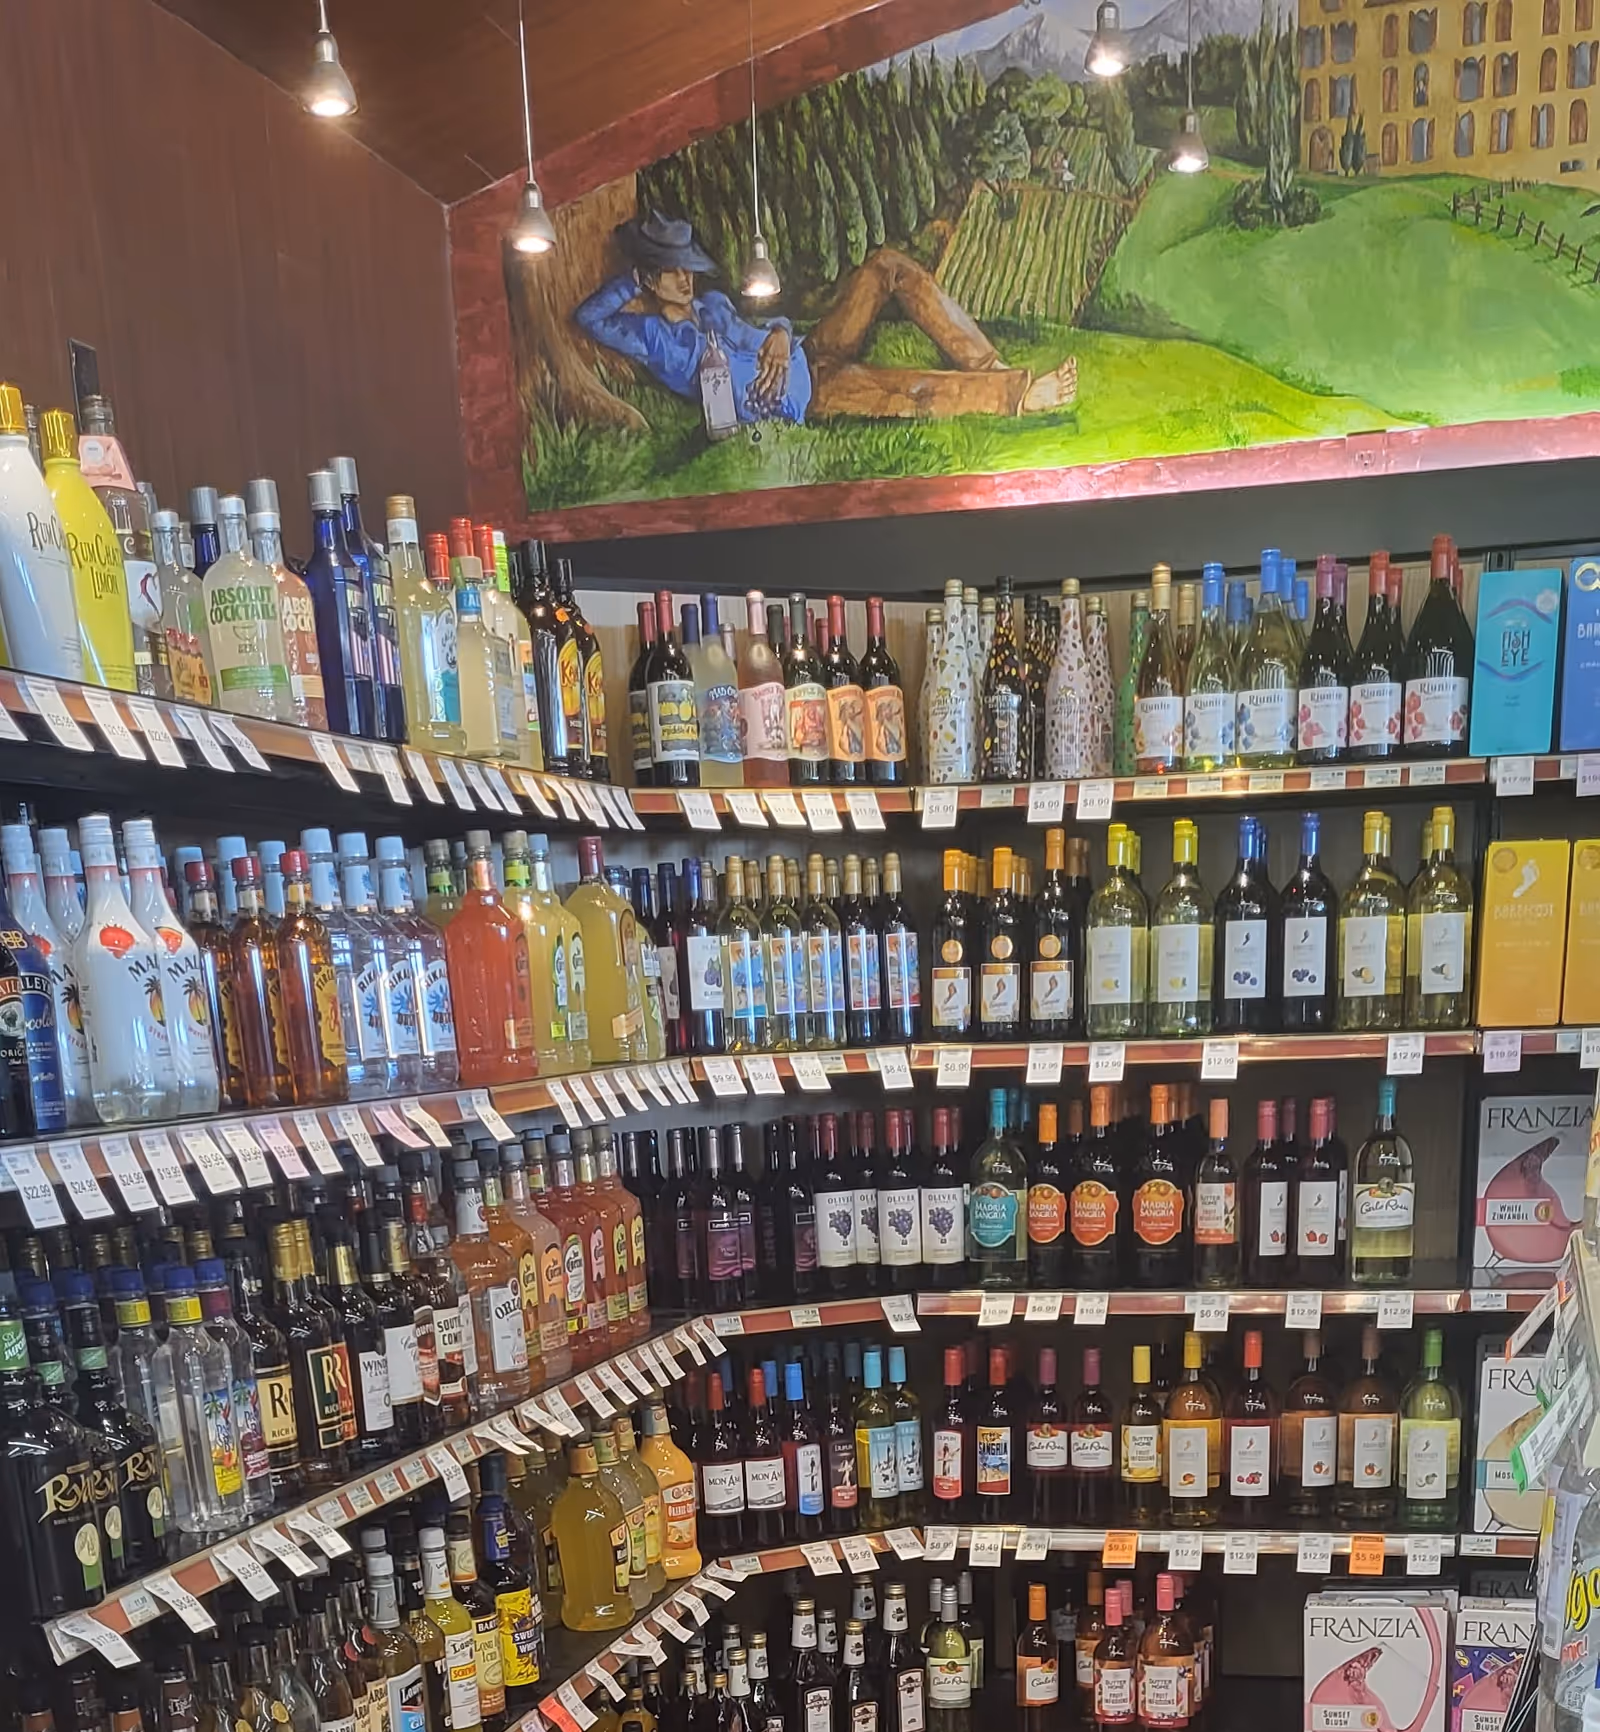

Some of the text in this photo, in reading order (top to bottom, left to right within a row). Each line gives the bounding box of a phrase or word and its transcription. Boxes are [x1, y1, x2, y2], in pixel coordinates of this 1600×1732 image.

[211, 586, 272, 605] ABSOLUT
[210, 603, 275, 624] COCKTAILS
[1503, 631, 1531, 651] FISH
[1502, 649, 1530, 668] EYE
[199, 1153, 225, 1172] $9.99
[119, 1172, 144, 1186] $24.99
[70, 1179, 97, 1194] $24.99
[24, 1184, 51, 1200] $22.99
[975, 1202, 1005, 1211] MADRIA
[1029, 1203, 1057, 1211] MADRIA
[1075, 1202, 1106, 1211] MADRIA
[1140, 1201, 1174, 1210] MADRIA
[975, 1210, 1006, 1220] SANGRIA
[1075, 1210, 1106, 1219] SANGRIA
[1140, 1209, 1174, 1218] SANGRIA
[1175, 1549, 1200, 1557] $12.99
[1230, 1552, 1255, 1560] $12.99
[1302, 1552, 1329, 1560] $12.99
[1355, 1553, 1381, 1561] $5.98
[1412, 1554, 1439, 1563] $12.99
[1309, 1617, 1421, 1643] FRANZIA
[1323, 1709, 1350, 1718] SUNSET
[1325, 1718, 1348, 1726] BLUSH
